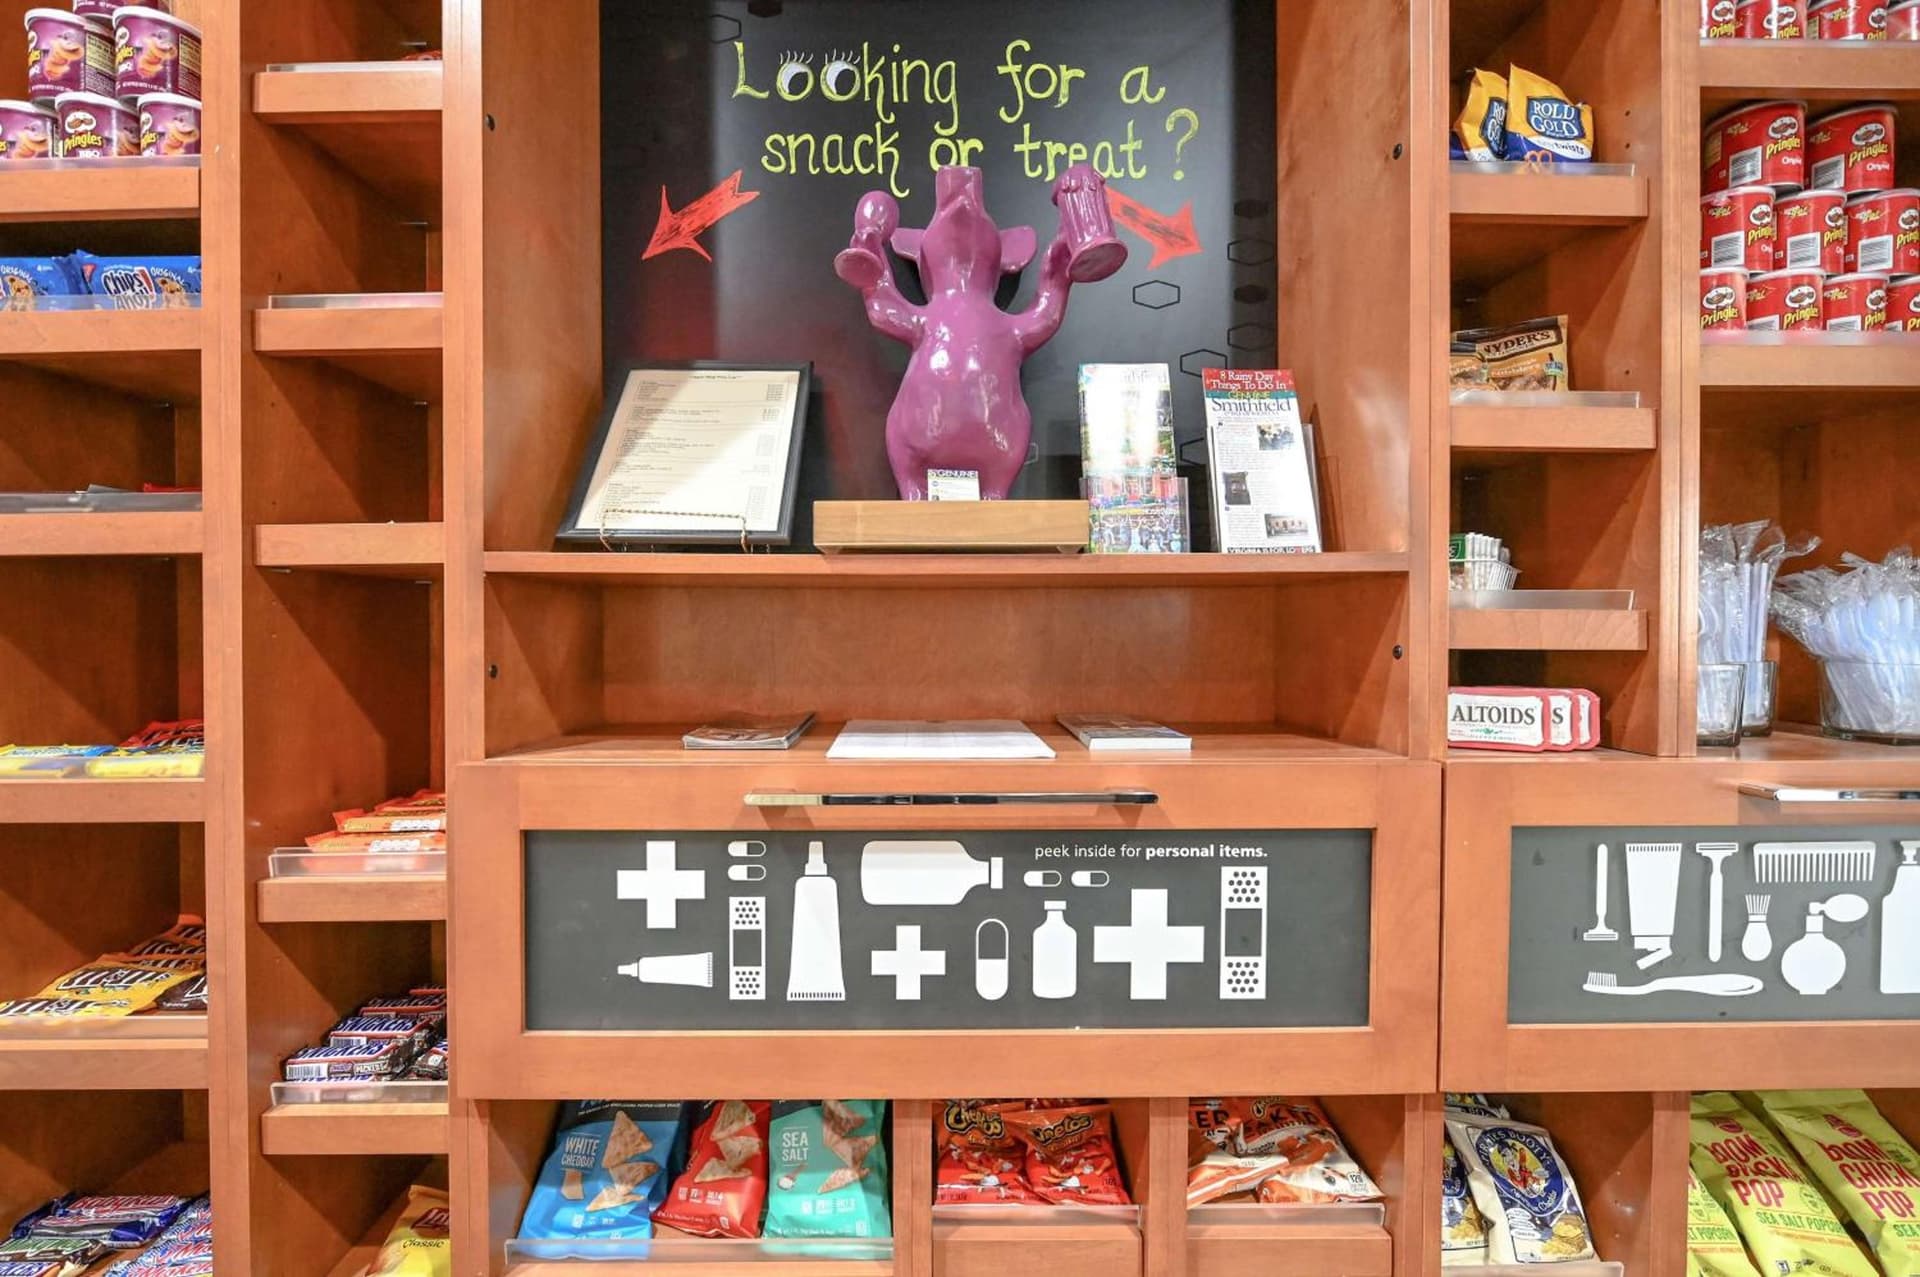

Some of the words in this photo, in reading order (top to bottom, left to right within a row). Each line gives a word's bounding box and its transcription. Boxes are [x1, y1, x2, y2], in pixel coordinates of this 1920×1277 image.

[732, 42, 958, 135] Looking
[997, 39, 1086, 123] for
[1120, 65, 1166, 105] a
[1533, 101, 1576, 120] ROLD
[1530, 115, 1580, 136] GOLD
[63, 131, 103, 156] Pringles
[761, 120, 909, 198] snack
[929, 136, 984, 168] or
[1014, 120, 1148, 182] treat
[103, 271, 145, 299] Chips
[1210, 380, 1241, 392] Things
[1242, 380, 1257, 390] To
[1258, 380, 1274, 390] Do
[1276, 380, 1288, 390] In
[1228, 371, 1254, 382] Rainy
[1255, 371, 1275, 383] Day
[1211, 398, 1291, 412] Smithfield
[1452, 705, 1536, 726] ALTOIDS
[1035, 845, 1070, 860] peek
[1074, 844, 1116, 857] inside
[1120, 844, 1142, 857] for
[1146, 844, 1215, 860] personal
[1219, 845, 1268, 858] items.
[564, 1136, 600, 1156] WHITE
[782, 1131, 809, 1148] SEA
[782, 1147, 808, 1161] SALT
[1731, 1179, 1785, 1208] POP
[1860, 1190, 1916, 1219] POP
[1756, 1211, 1779, 1225] SEA
[402, 1239, 445, 1249] Classic
